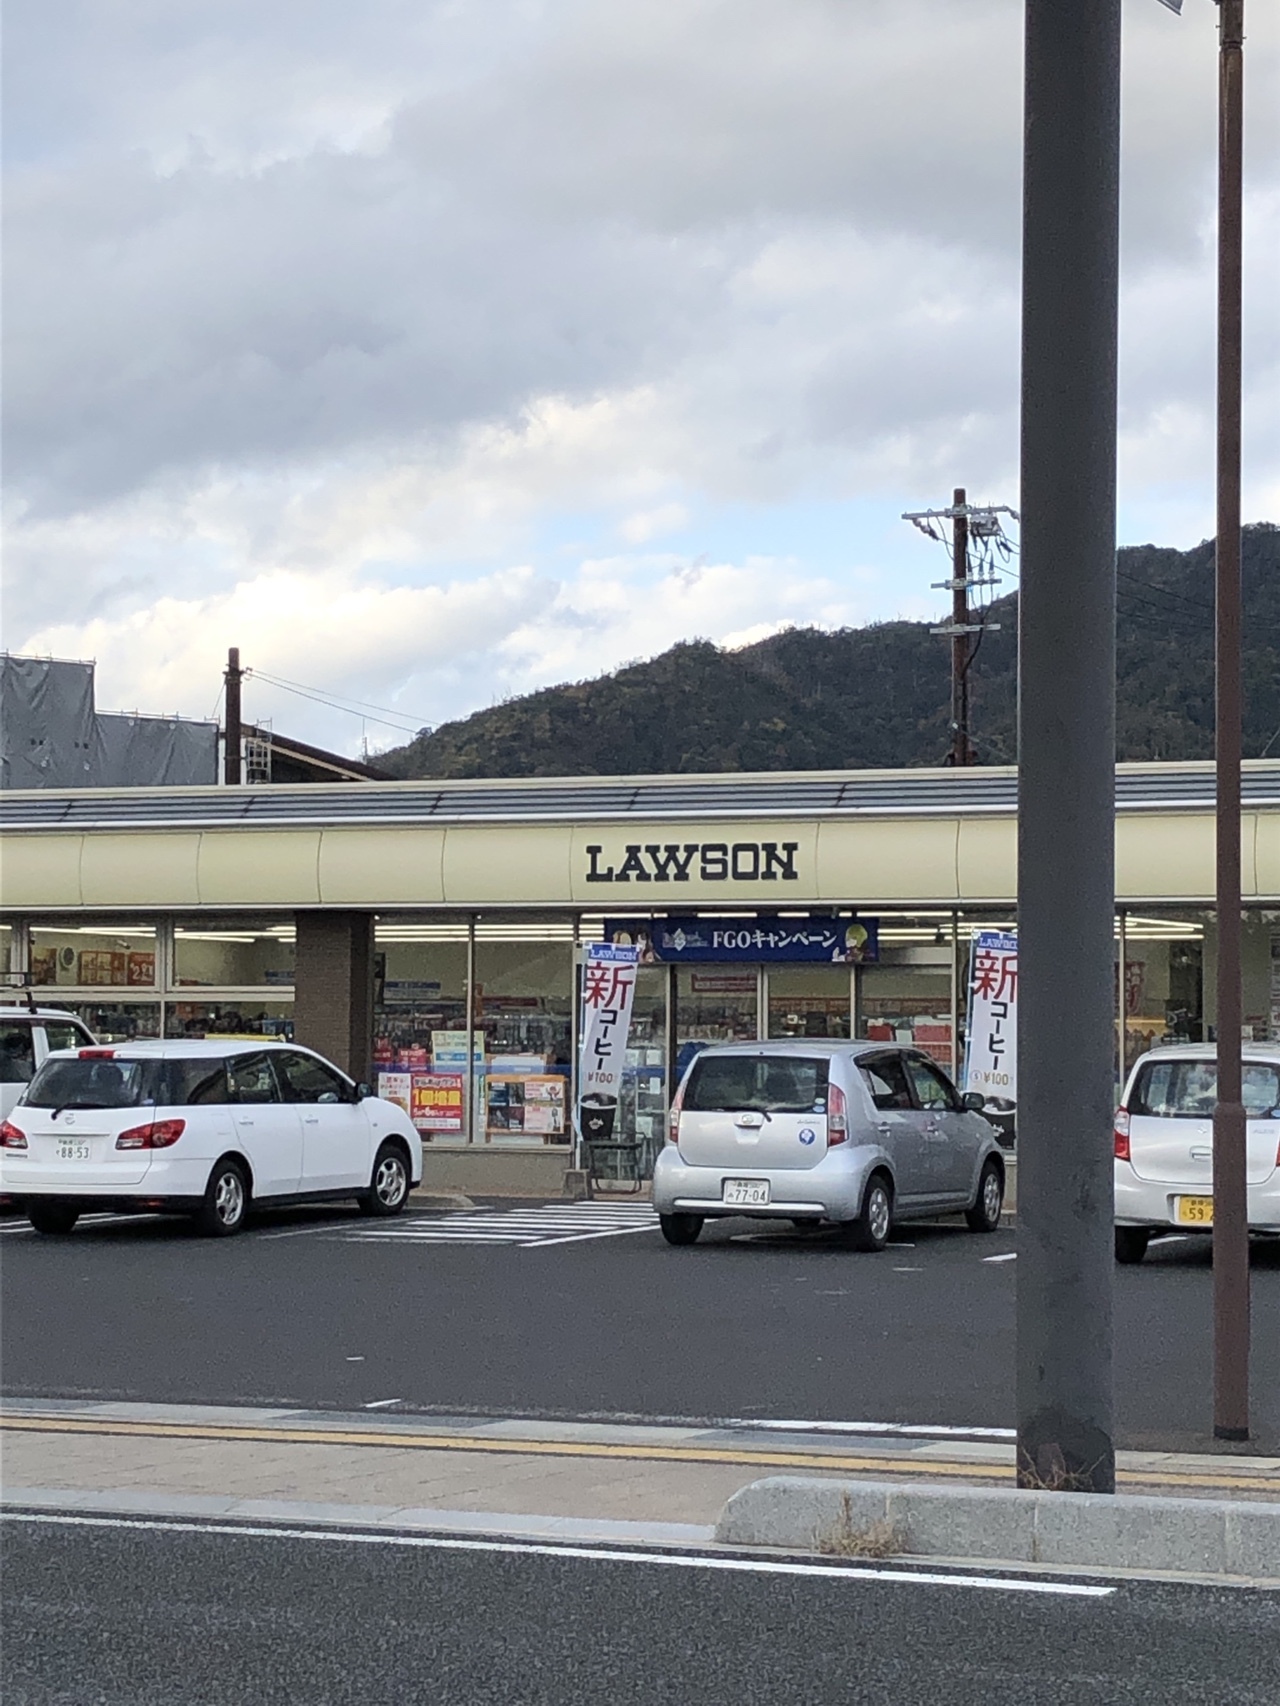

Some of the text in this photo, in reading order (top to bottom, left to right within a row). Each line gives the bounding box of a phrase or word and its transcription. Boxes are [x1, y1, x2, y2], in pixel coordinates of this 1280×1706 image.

[586, 842, 799, 882] LAWSON
[712, 928, 837, 949] FGOキャンペーン
[978, 937, 1018, 950] LAWSO
[589, 948, 638, 961] LAWSON
[587, 1071, 613, 1084] ¥100
[984, 1072, 1009, 1085] ¥100
[61, 1147, 89, 1159] 88-53
[736, 1189, 766, 1202] 77-04
